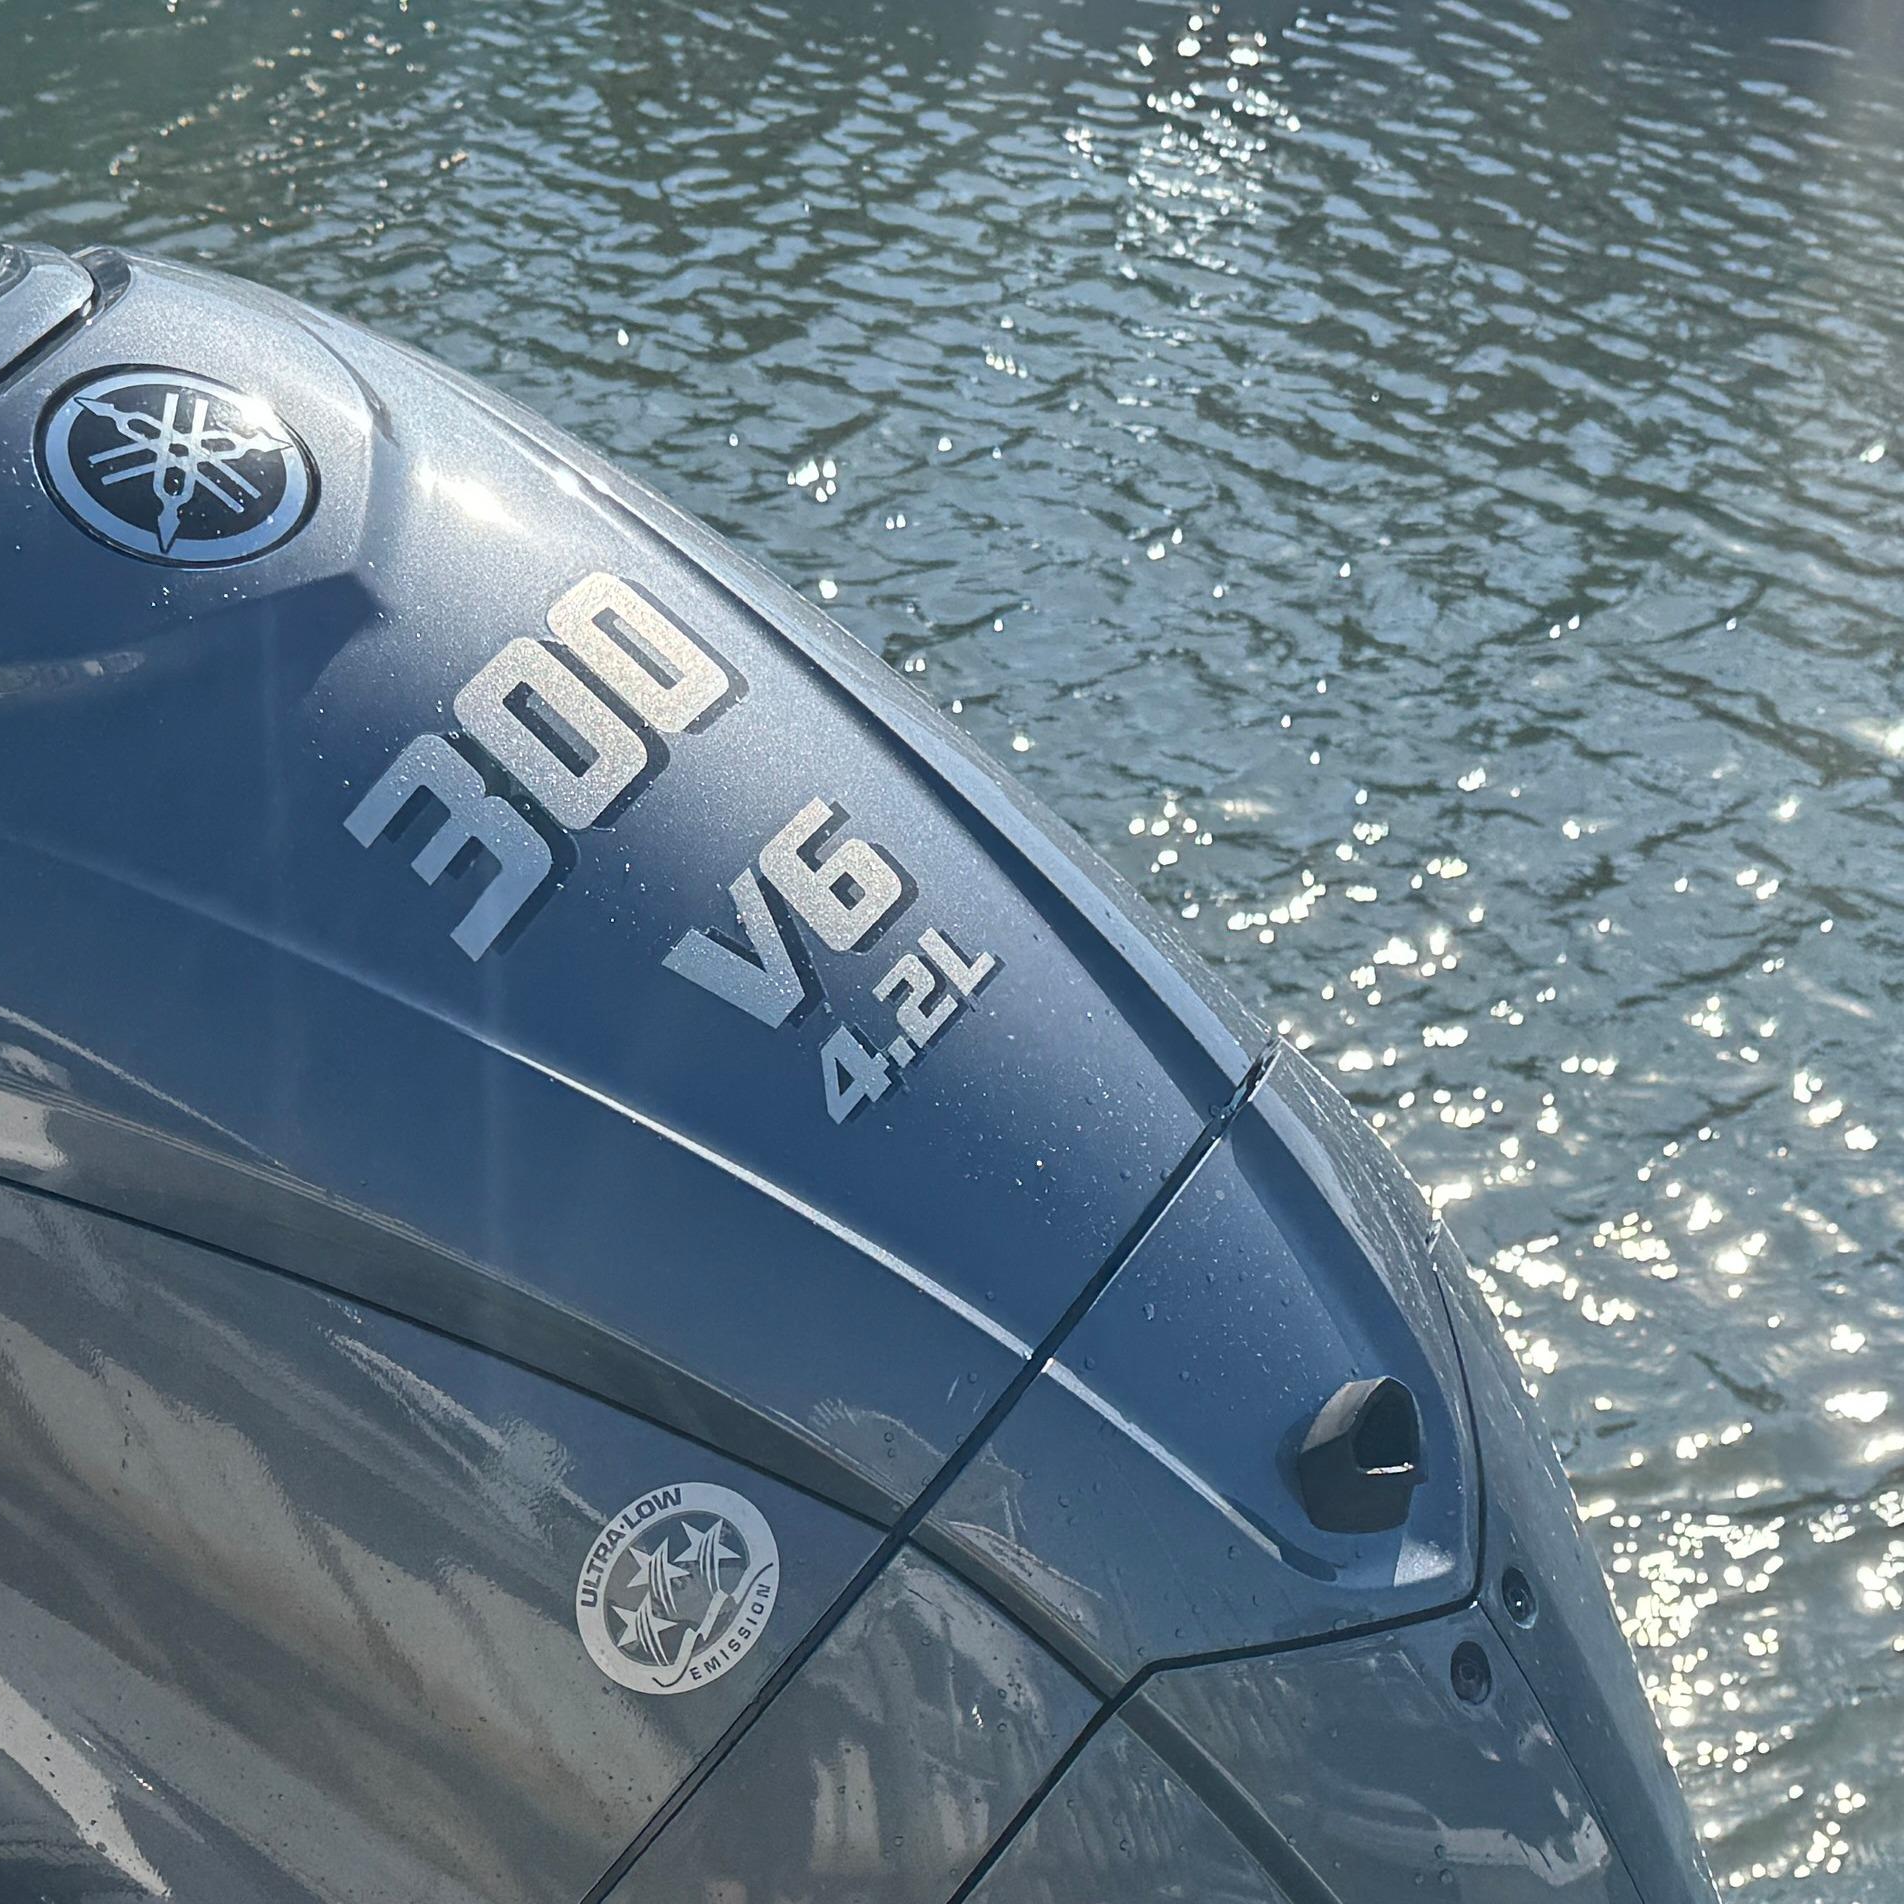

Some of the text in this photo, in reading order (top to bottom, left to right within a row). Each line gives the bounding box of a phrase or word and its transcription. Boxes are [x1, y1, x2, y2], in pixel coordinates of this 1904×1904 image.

[343, 571, 744, 962] 300
[662, 797, 911, 1028] V6
[820, 928, 1000, 1125] 4.2L
[689, 1583, 771, 1681] EMISSION
